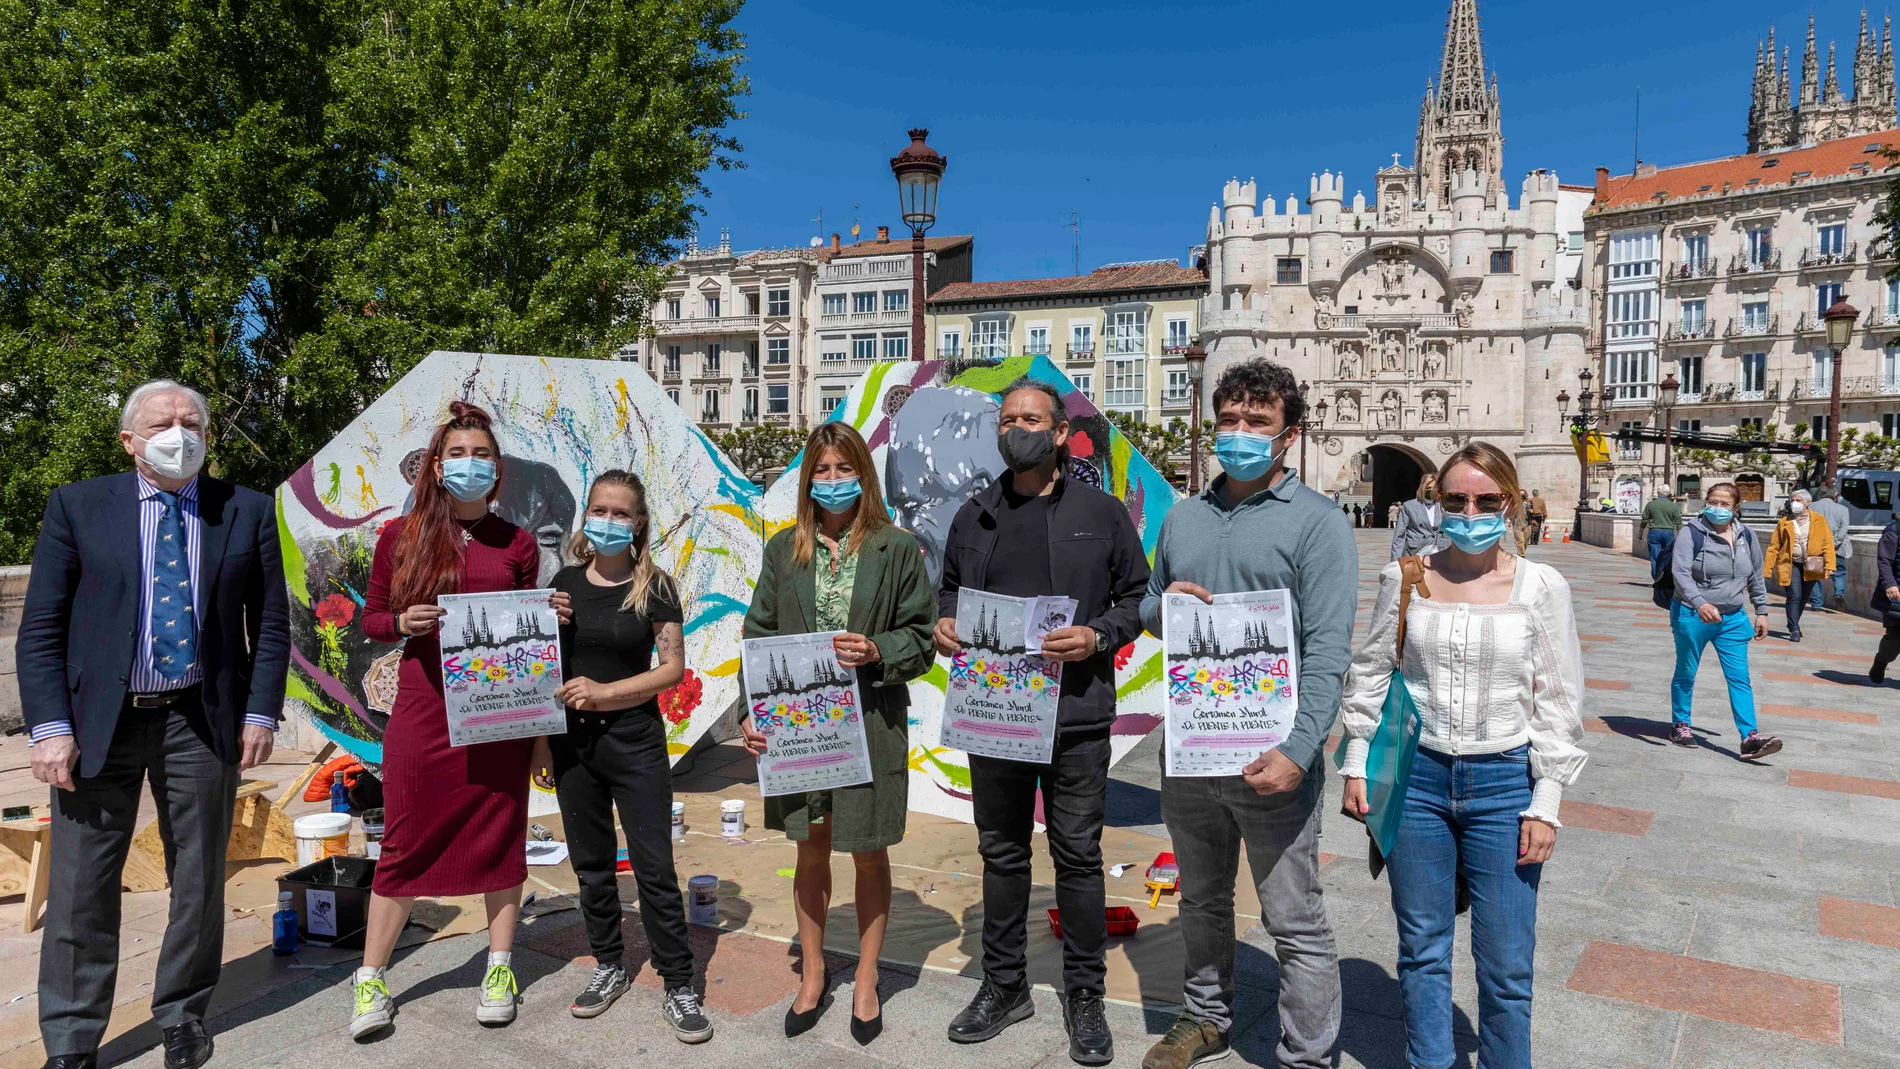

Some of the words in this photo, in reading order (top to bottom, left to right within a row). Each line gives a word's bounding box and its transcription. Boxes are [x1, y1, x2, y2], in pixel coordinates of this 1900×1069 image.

[469, 692, 510, 704] Certamen
[512, 687, 540, 699] Mural
[475, 702, 505, 712] PUENTE
[507, 701, 514, 709] A
[965, 695, 1004, 710] Certamen
[1006, 700, 1034, 712] Mural
[968, 708, 996, 720] PUENTE
[999, 713, 1005, 721] A
[1193, 708, 1236, 720] Certamen
[1239, 706, 1269, 718] Mural
[1198, 721, 1230, 731] PUENTE
[1232, 721, 1239, 731] A
[777, 737, 814, 748] Certamen
[815, 731, 841, 743] Mural
[782, 746, 809, 757] PUENTE
[811, 745, 817, 753] A
